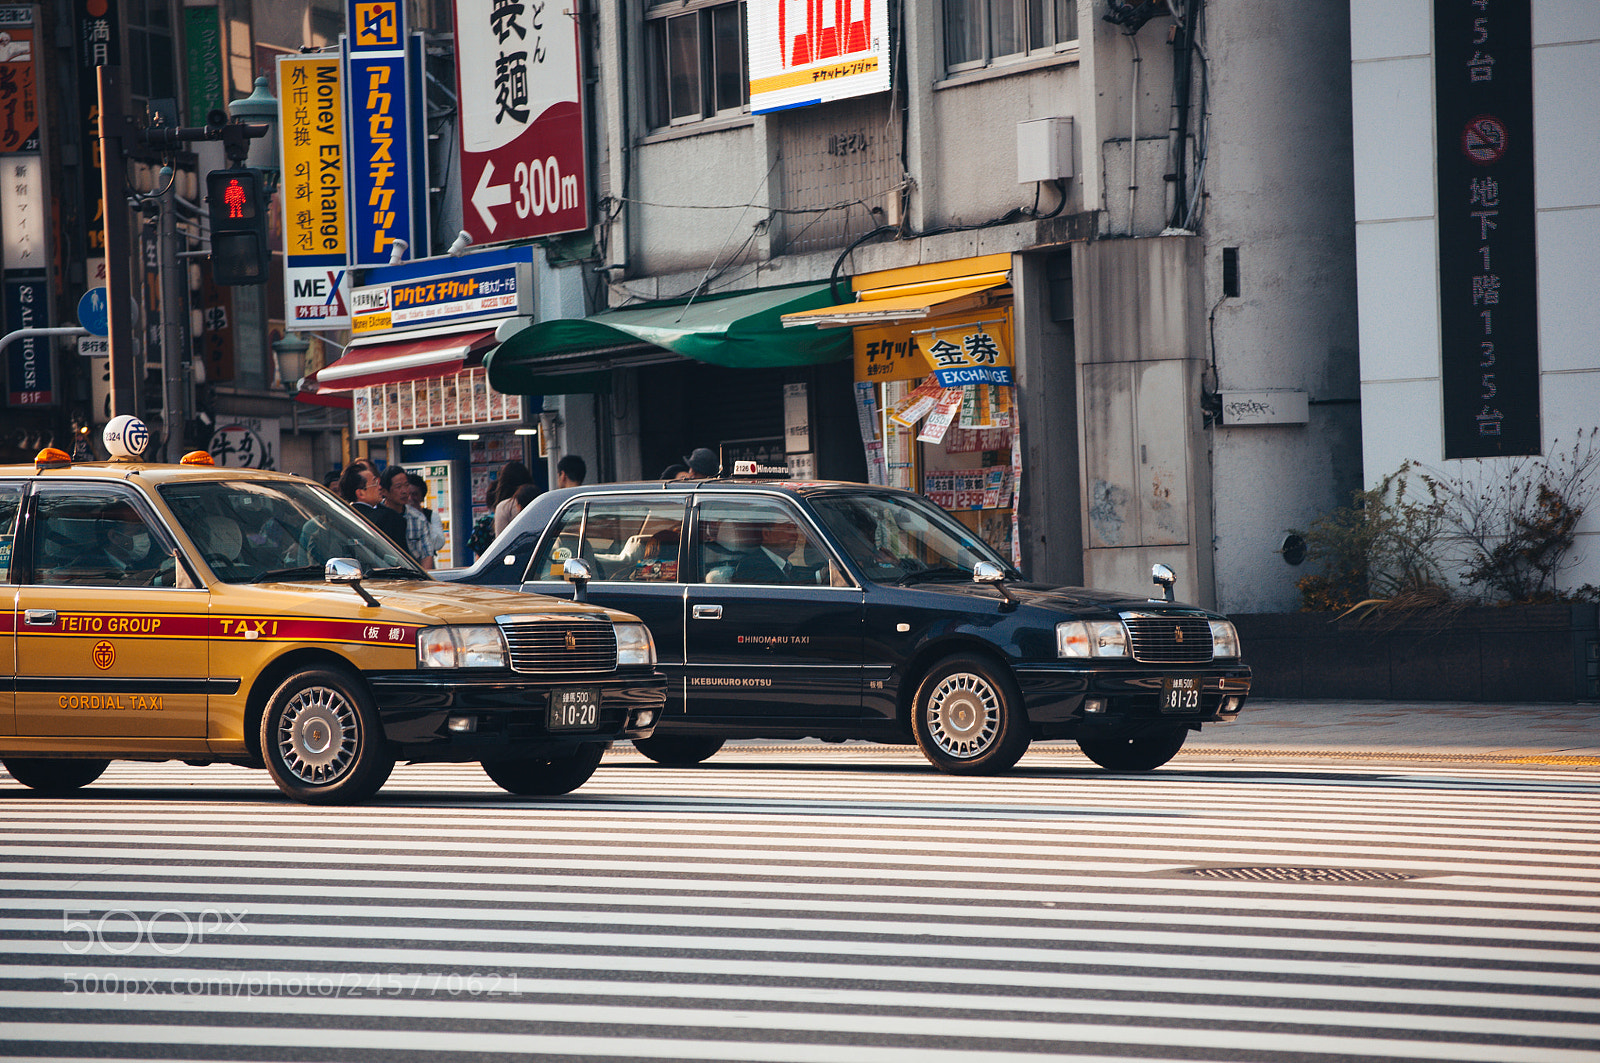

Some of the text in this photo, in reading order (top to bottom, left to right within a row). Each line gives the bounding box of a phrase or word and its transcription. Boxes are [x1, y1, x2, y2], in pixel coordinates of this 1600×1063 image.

[89, 19, 110, 66] 満月
[812, 59, 879, 82] チケットレンジャー
[291, 65, 312, 147] 外币兑换
[316, 66, 338, 135] Money
[366, 65, 396, 253] アクセスチケット
[513, 155, 579, 219] 300m
[293, 161, 315, 251] 외화 환전
[293, 270, 347, 306] MEX
[393, 278, 480, 307] アクセスチケット
[370, 288, 391, 308] MEX
[480, 295, 516, 309] ACCESS TICKET
[298, 305, 339, 318] 外貨両替
[866, 335, 919, 363] チケット
[930, 333, 1000, 367] 金券
[23, 338, 37, 389] HOUSE
[866, 361, 895, 376] 金券ショップ
[942, 369, 1010, 384] EXCHANGE
[20, 391, 41, 404] B1F
[211, 431, 254, 467] 牛カツ
[432, 466, 446, 476] JR
[756, 464, 789, 474] Hinomaru
[60, 617, 161, 633] TEITO GROUP
[219, 619, 278, 635] TAXI
[745, 636, 810, 644] HINOMARU TAXI
[691, 677, 772, 687] IKEBUKURO KOTSU
[1183, 678, 1194, 688] 500
[58, 694, 164, 711] CORDIAL TAXI
[576, 691, 589, 703] 500
